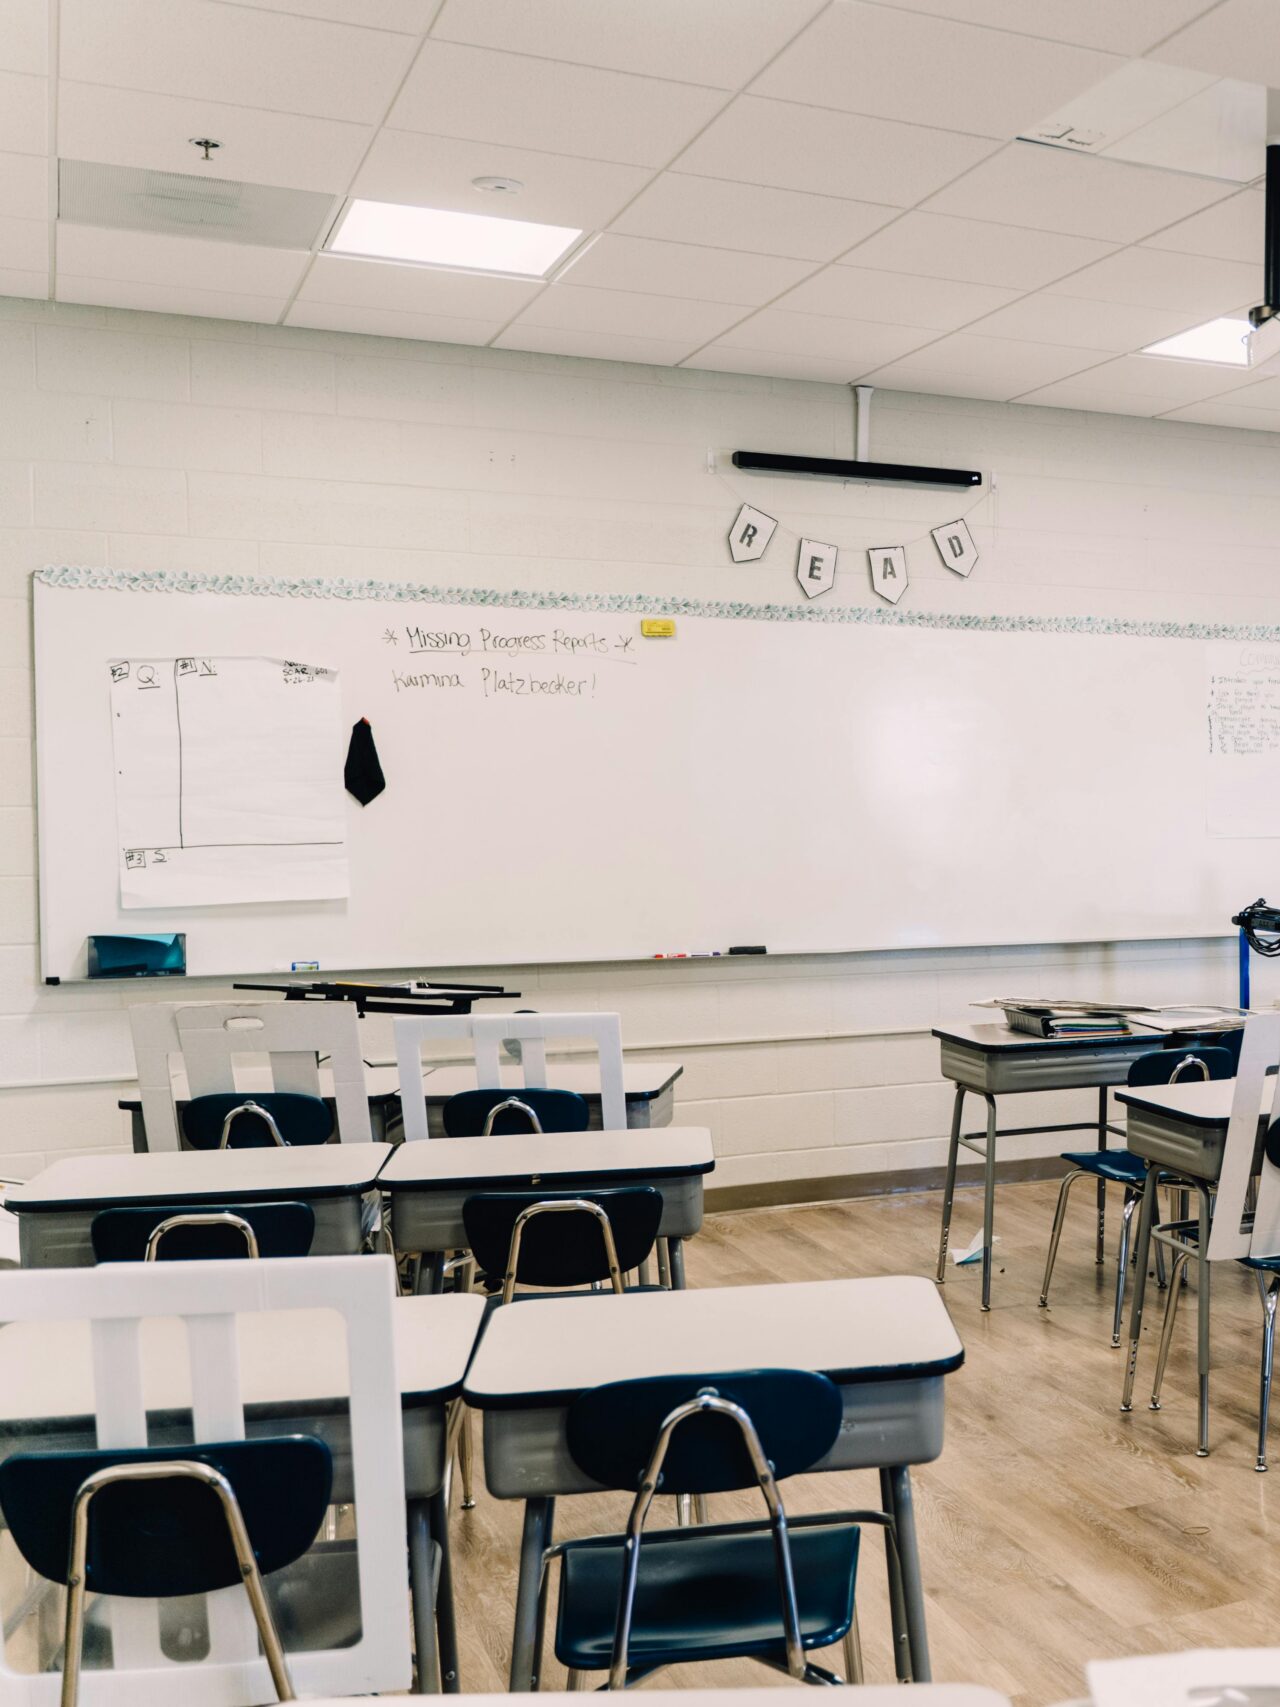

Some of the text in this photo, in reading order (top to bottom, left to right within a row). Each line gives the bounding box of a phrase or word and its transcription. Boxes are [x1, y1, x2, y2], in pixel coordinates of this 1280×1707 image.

[406, 626, 609, 657] Missing Progress Reports
[481, 667, 596, 698] Platzbecker!
